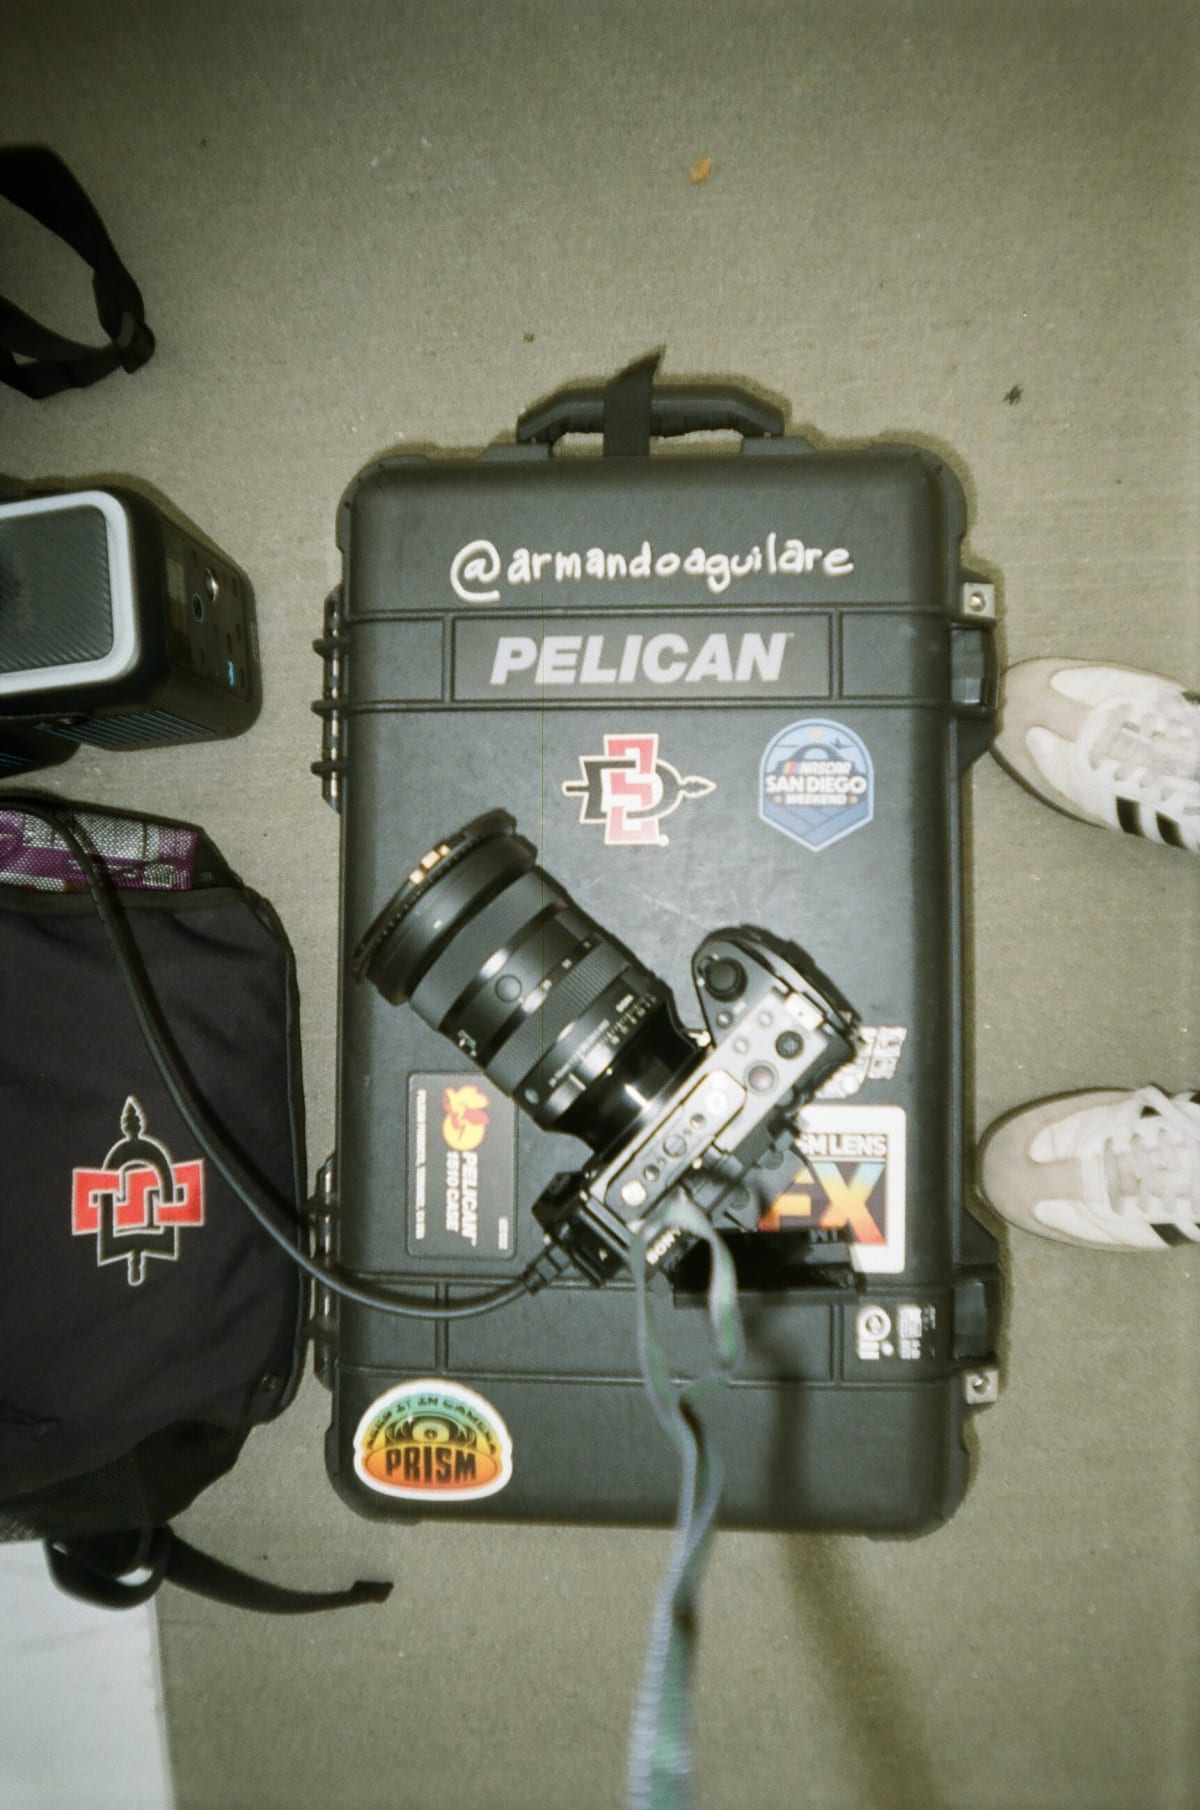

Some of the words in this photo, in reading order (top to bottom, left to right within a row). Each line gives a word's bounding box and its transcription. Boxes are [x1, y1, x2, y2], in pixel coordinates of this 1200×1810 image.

[450, 532, 855, 602] @armandoaguilare
[490, 632, 788, 686] PELICAN
[765, 774, 805, 793] SAN
[806, 775, 868, 795] DIEGO
[784, 793, 848, 806] WEEKEND
[829, 1133, 887, 1157] LENS
[446, 1150, 460, 1188] 1510
[445, 1188, 460, 1233] CASE
[461, 1151, 478, 1239] PELICAN
[385, 1446, 477, 1484] PRISM
